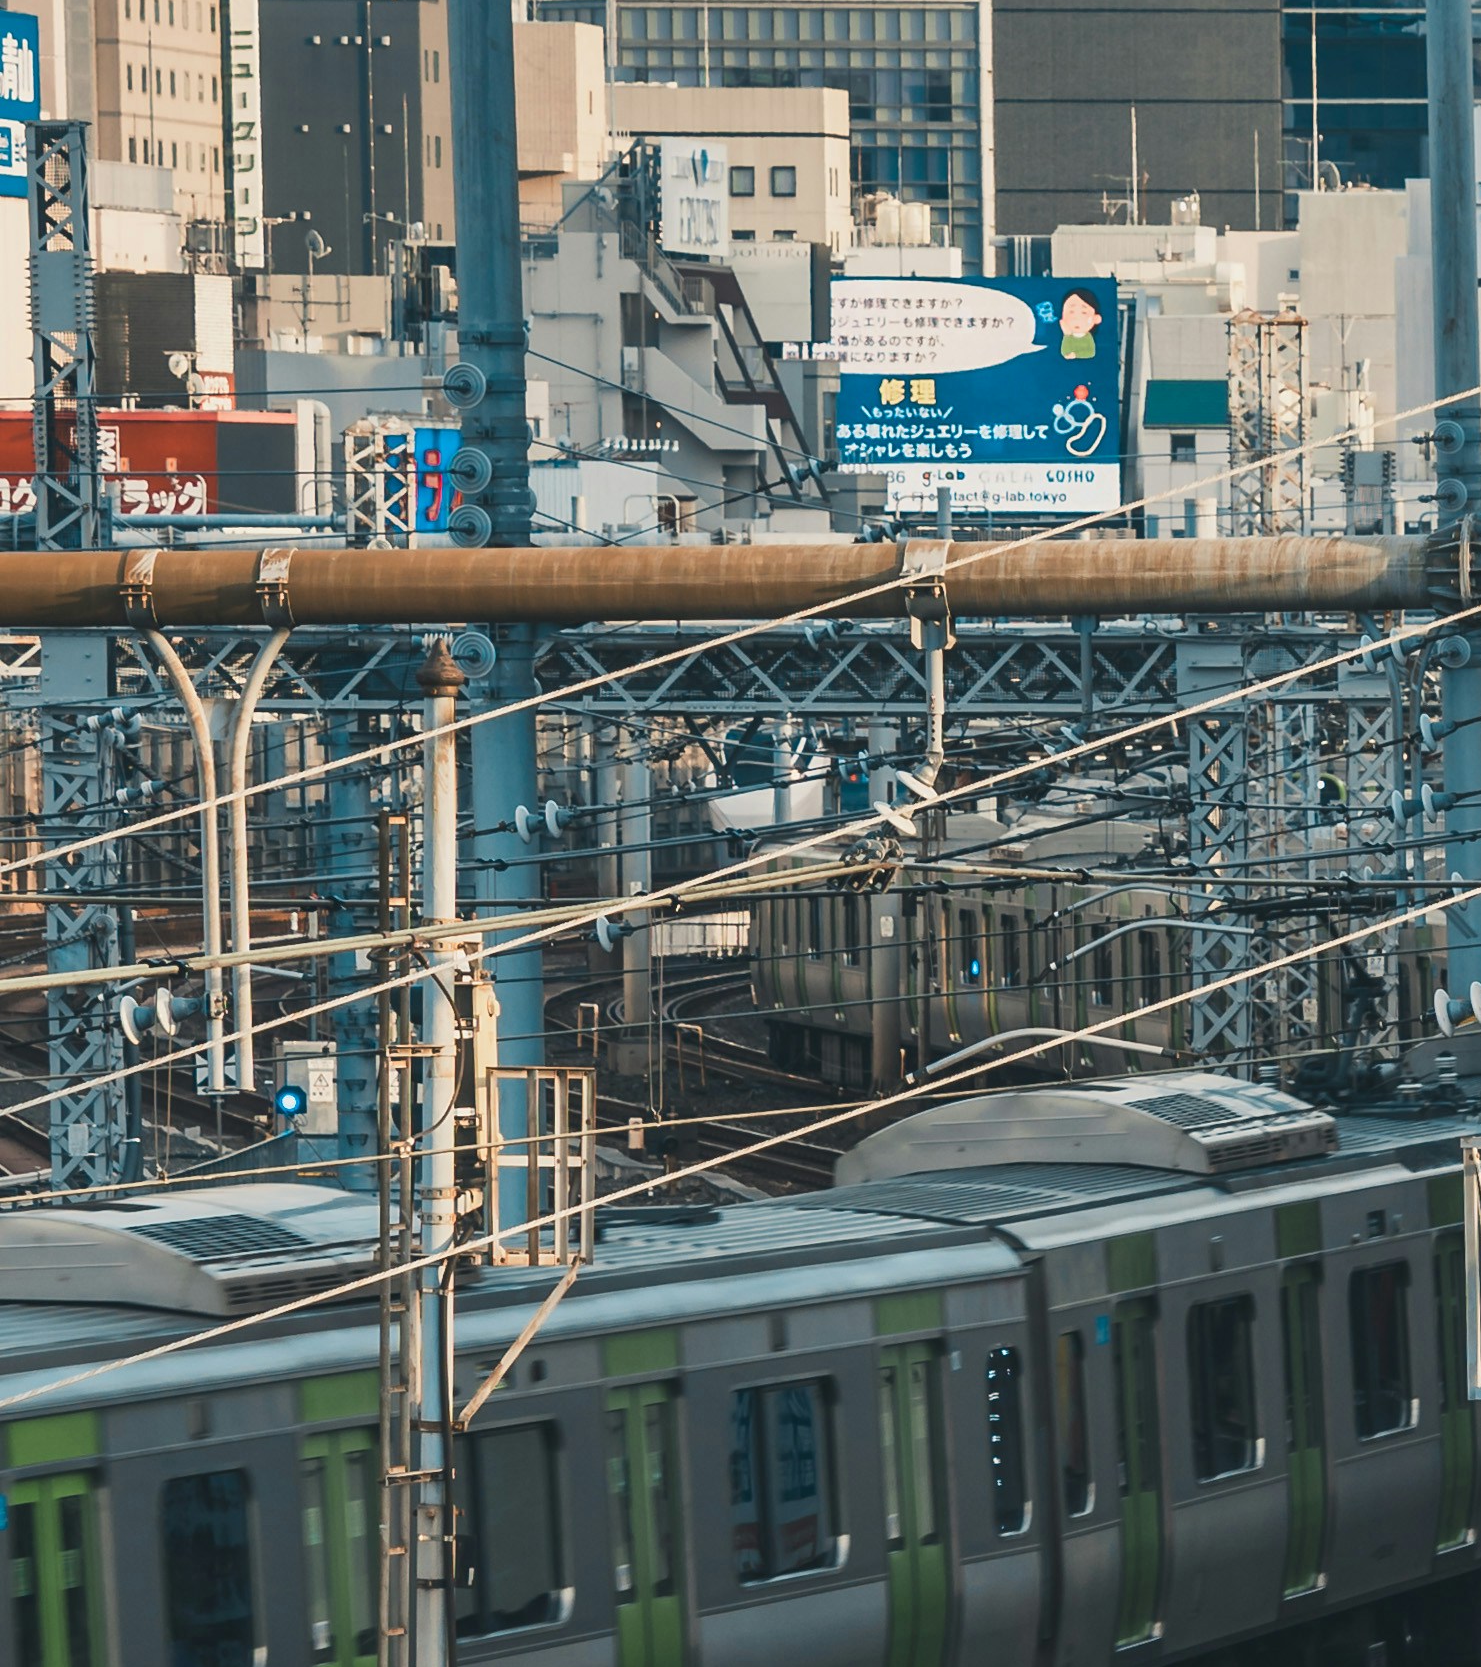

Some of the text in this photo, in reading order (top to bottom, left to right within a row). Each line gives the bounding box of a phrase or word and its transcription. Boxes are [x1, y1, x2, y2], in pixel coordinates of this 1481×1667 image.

[231, 29, 258, 237] ニューグリーン
[879, 378, 937, 405] 修理
